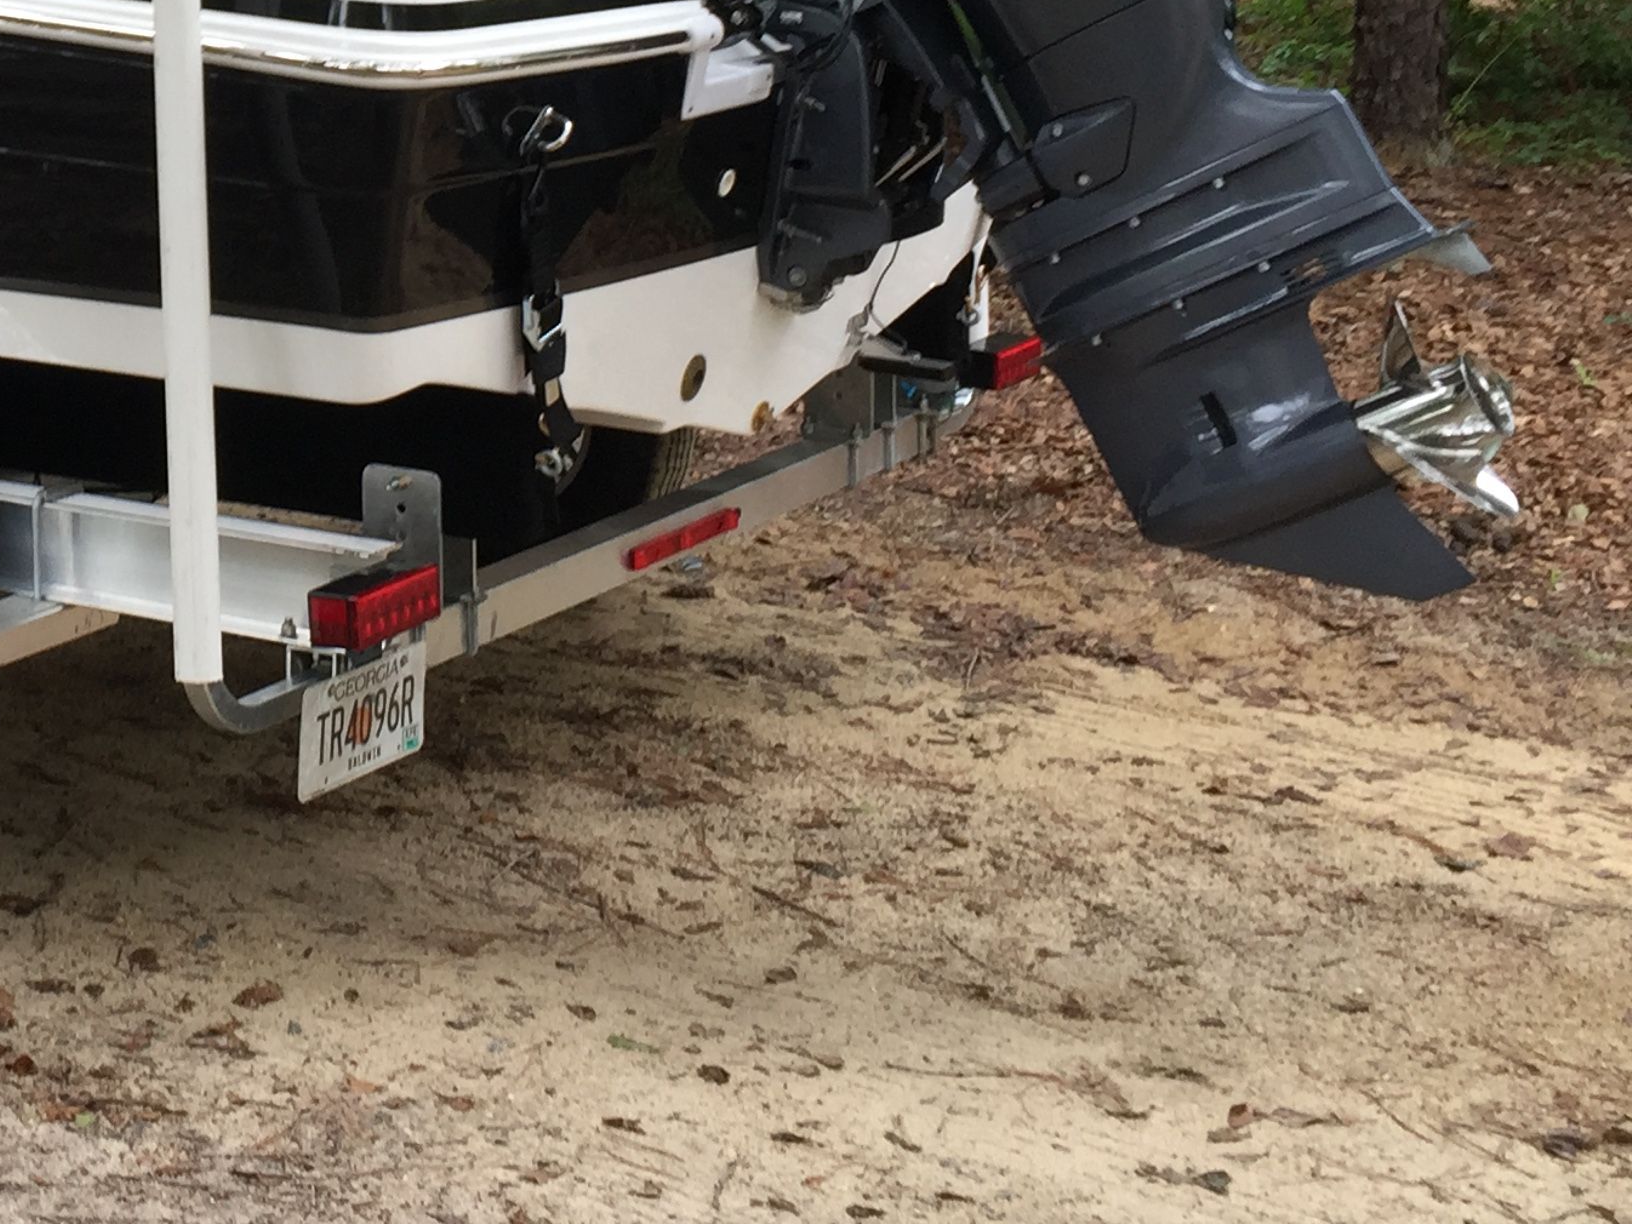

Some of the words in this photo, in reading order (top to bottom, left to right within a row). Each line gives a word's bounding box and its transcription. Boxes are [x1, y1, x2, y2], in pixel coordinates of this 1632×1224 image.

[333, 657, 400, 703] GEORGIA
[316, 674, 415, 767] TR4096R
[347, 745, 382, 771] BALDWIN
